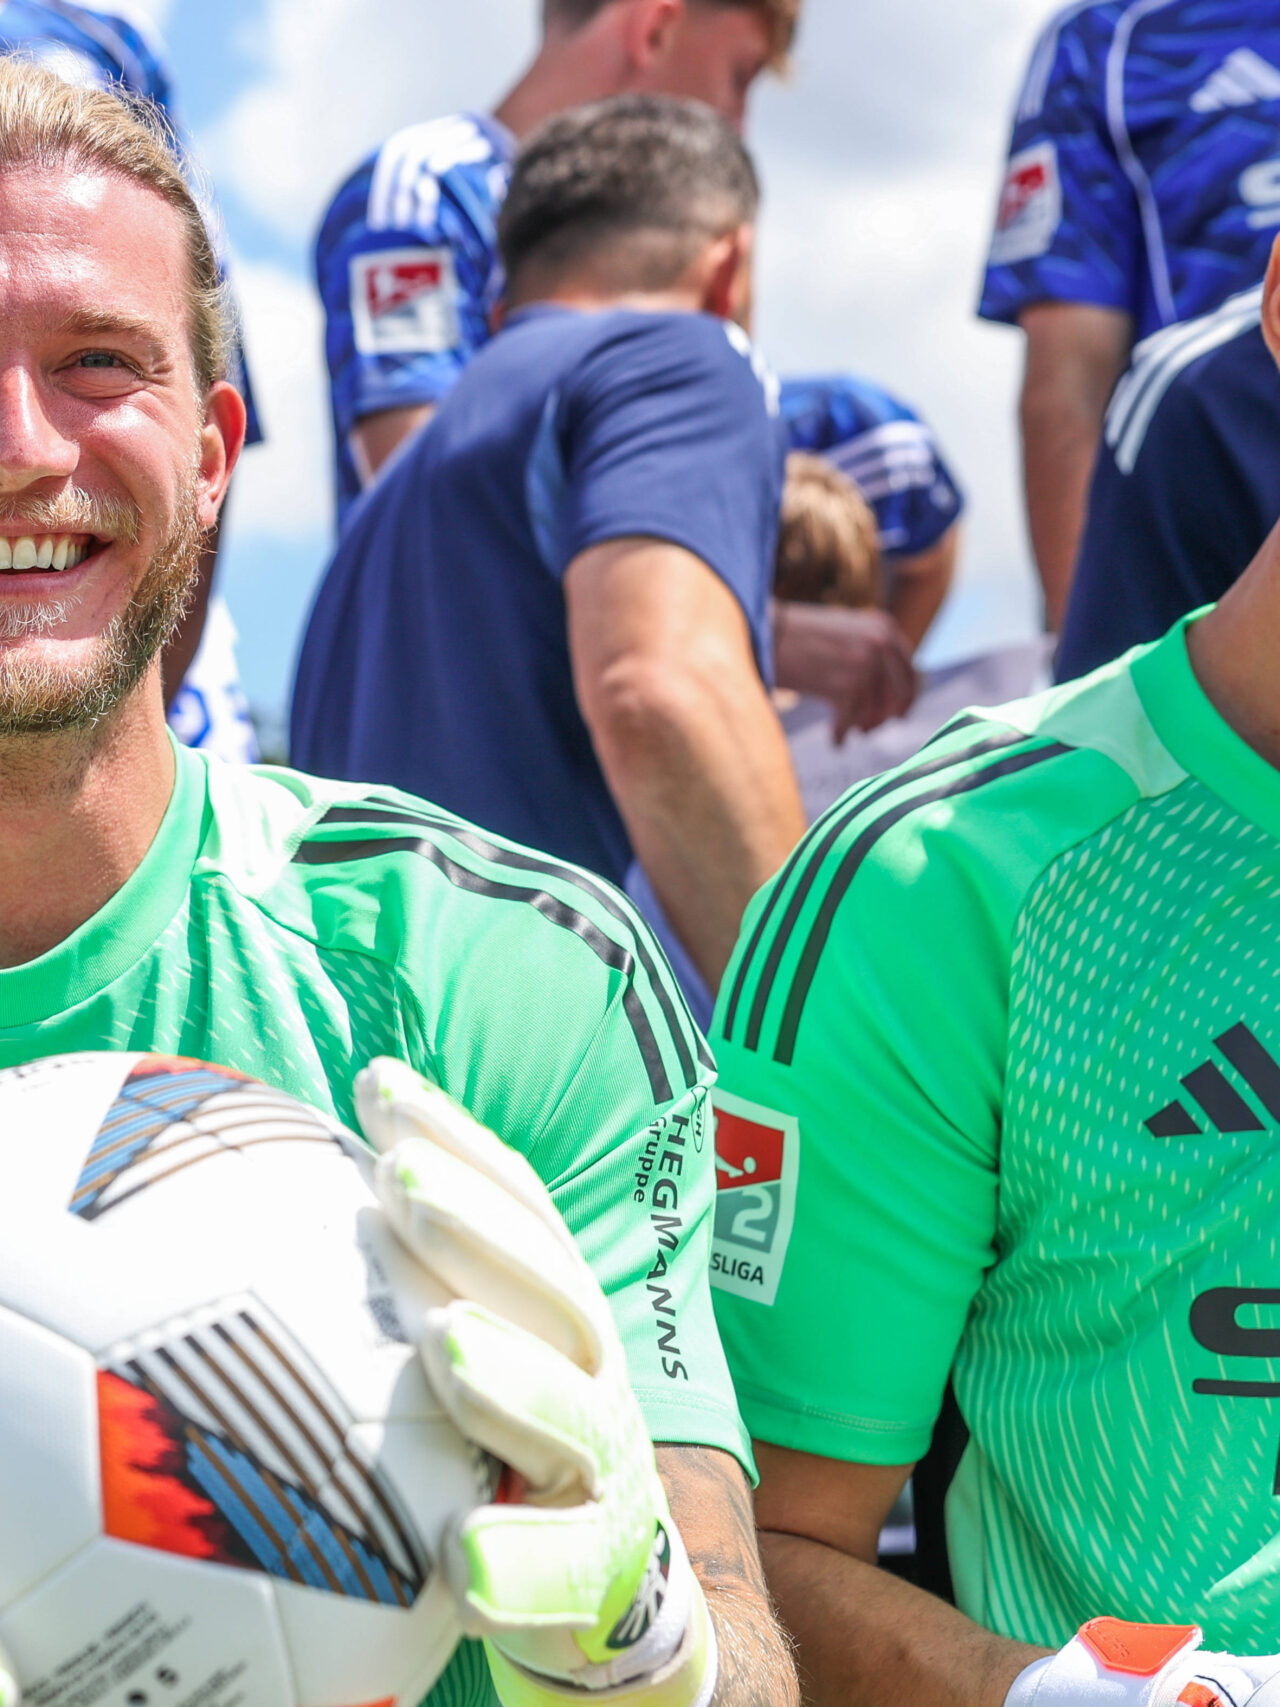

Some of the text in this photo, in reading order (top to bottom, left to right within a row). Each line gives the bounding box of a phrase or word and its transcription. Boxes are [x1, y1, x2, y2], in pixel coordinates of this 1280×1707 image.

[634, 1117, 667, 1203] Gruppe
[646, 1114, 689, 1381] HEGMANNS
[731, 1186, 773, 1243] 2
